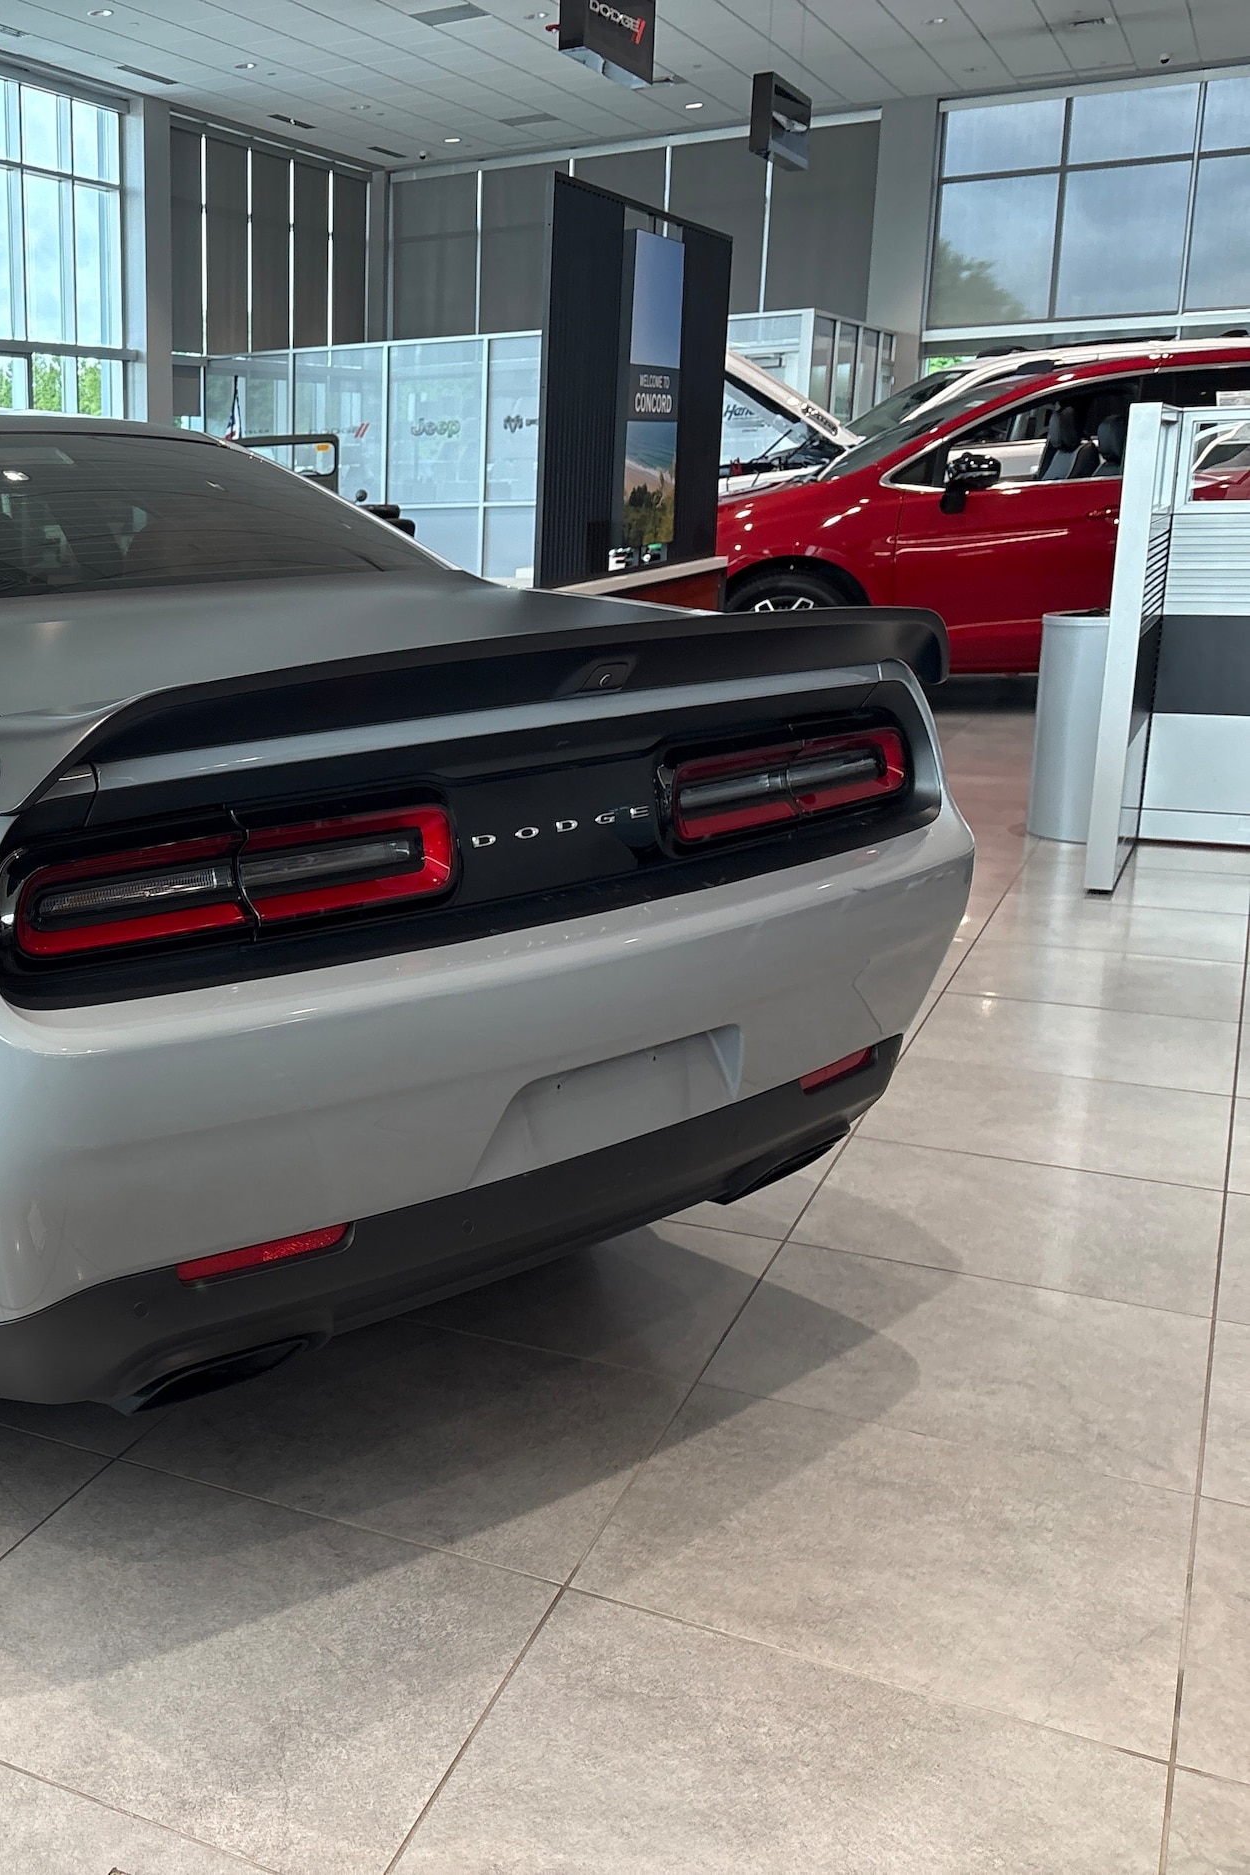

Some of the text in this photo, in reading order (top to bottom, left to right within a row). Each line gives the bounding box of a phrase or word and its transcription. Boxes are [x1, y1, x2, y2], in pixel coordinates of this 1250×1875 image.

[589, 0, 639, 32] DODGE
[639, 374, 670, 389] WELCOME TO
[634, 392, 673, 413] CONCORD
[411, 417, 461, 438] Jeep
[471, 806, 649, 848] DODGE
